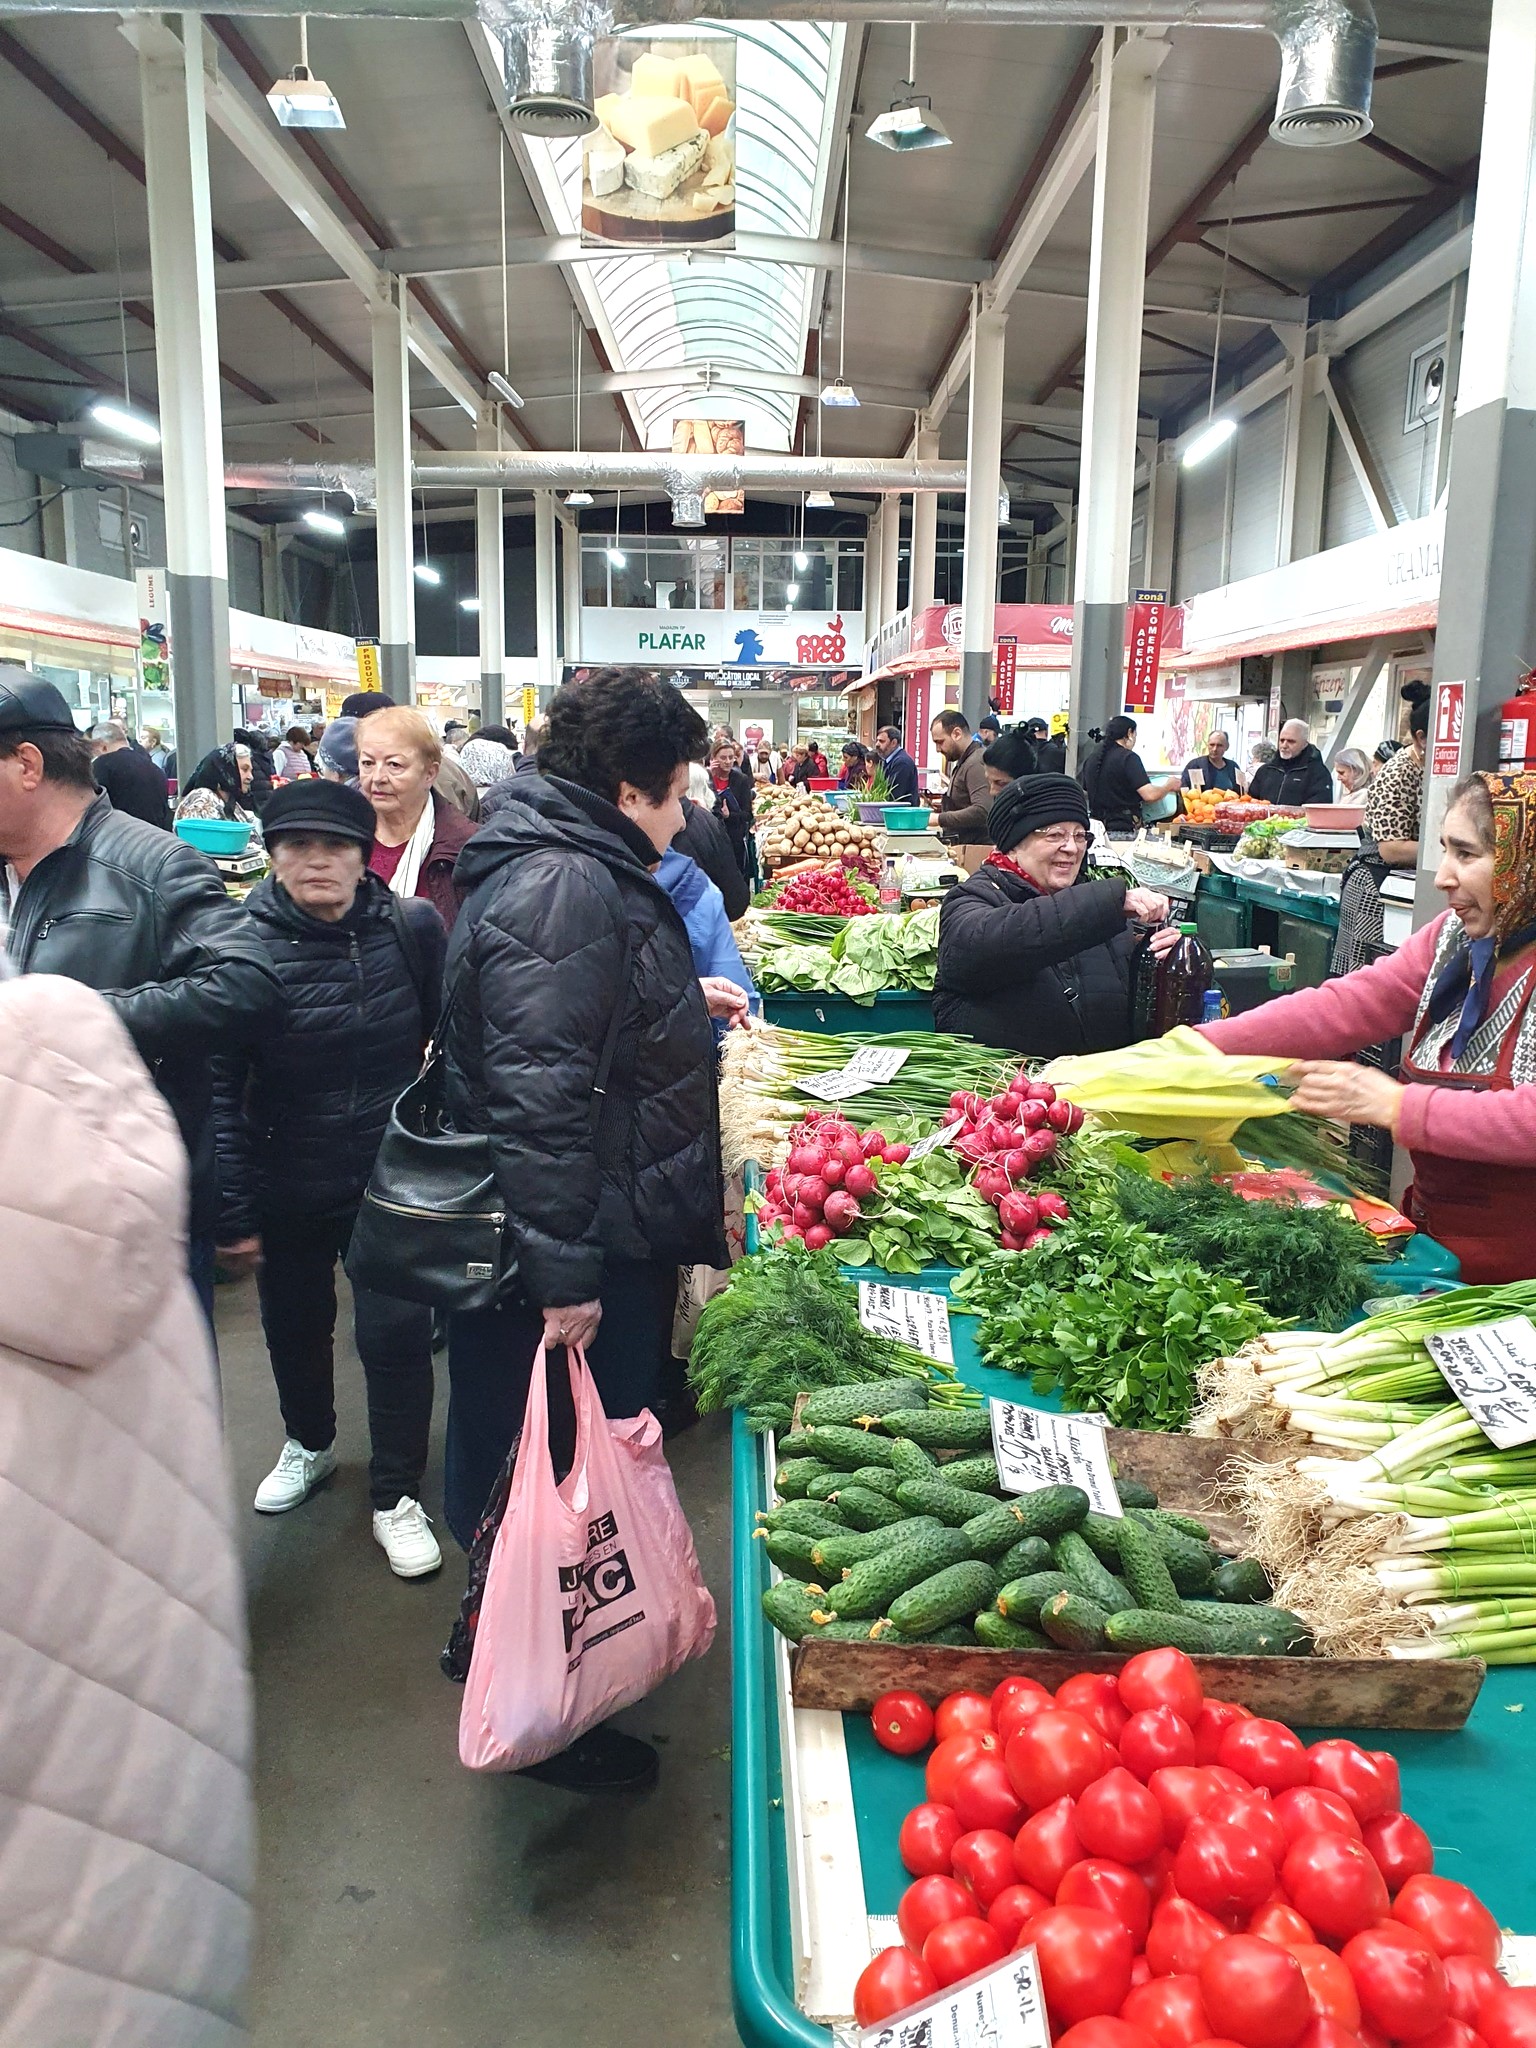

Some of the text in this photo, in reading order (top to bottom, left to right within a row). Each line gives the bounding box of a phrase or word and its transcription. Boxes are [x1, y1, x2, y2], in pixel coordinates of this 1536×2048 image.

[147, 574, 155, 608] LEGUME
[1138, 592, 1164, 602] zonă
[638, 632, 706, 650] PLAFAR
[796, 634, 846, 650] COCO
[797, 647, 846, 664] RICO
[1143, 606, 1159, 703] COMERCIALI
[742, 672, 761, 681] LOCAL
[1005, 645, 1013, 709] COMERCIALI
[1435, 747, 1459, 760] Extinctor
[1433, 761, 1441, 773] de
[603, 1541, 617, 1556] EN
